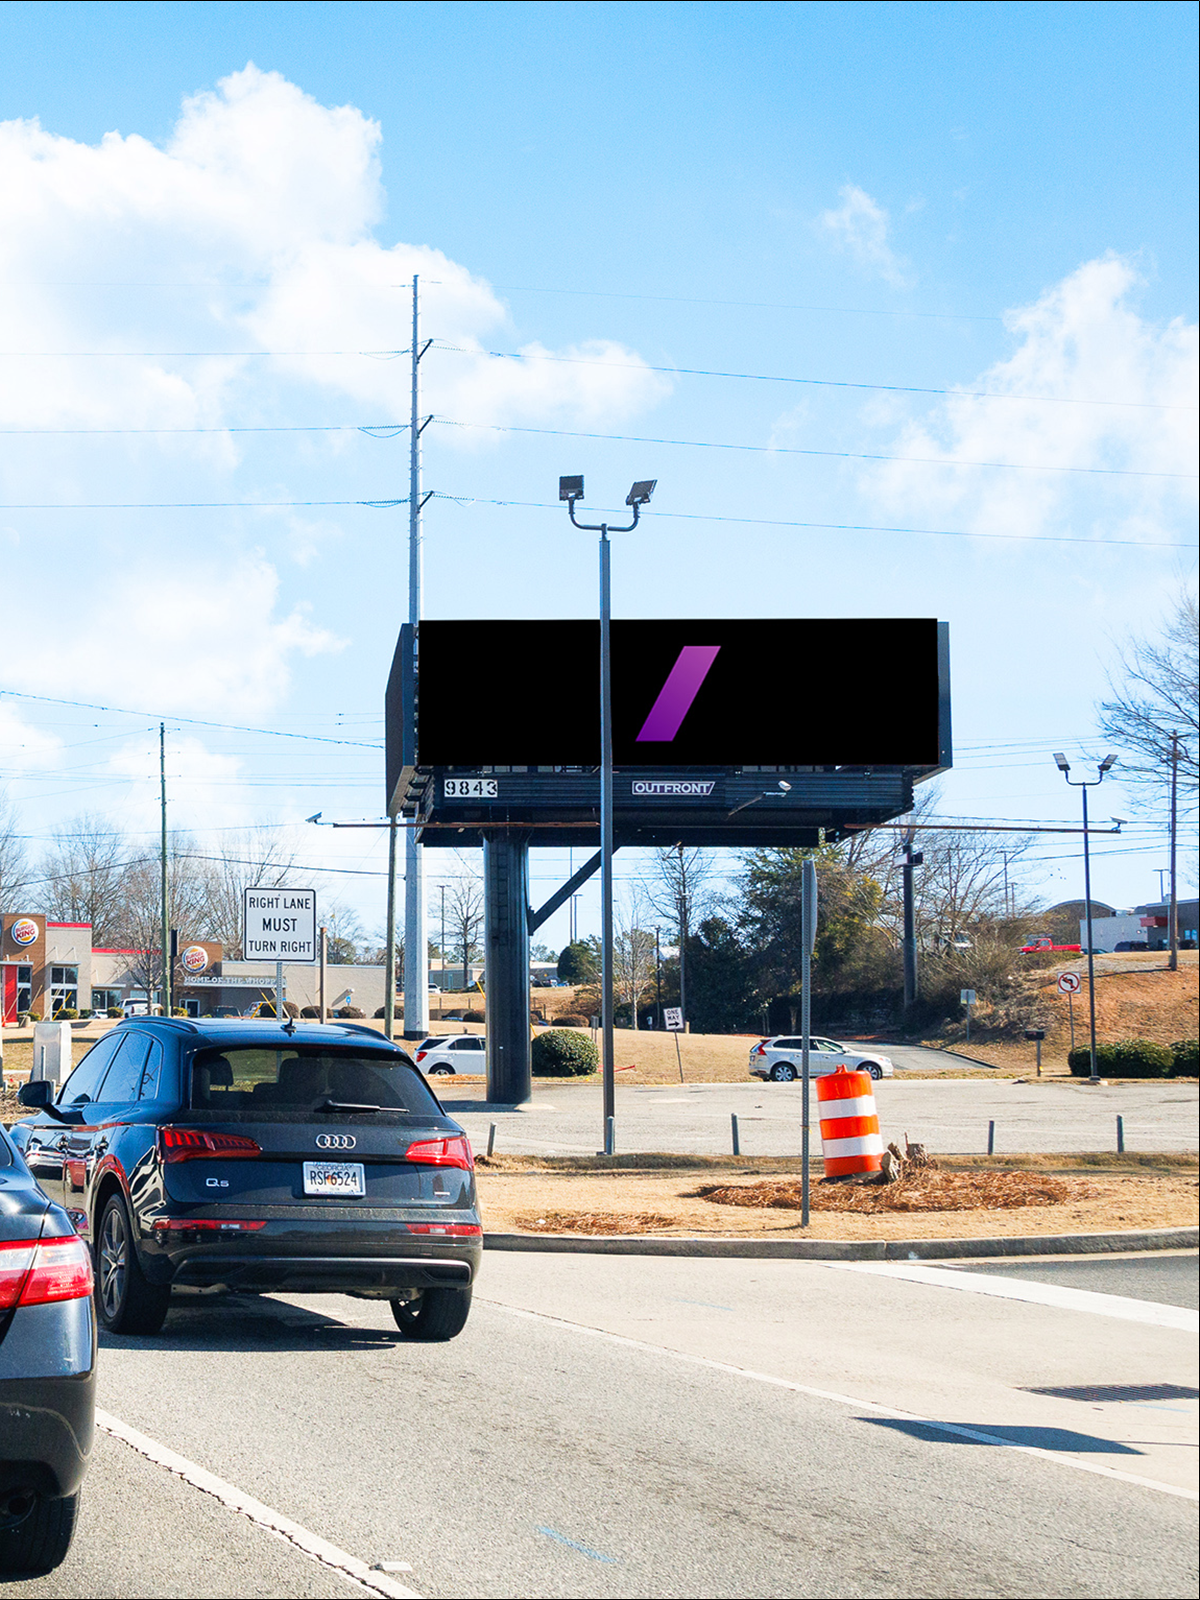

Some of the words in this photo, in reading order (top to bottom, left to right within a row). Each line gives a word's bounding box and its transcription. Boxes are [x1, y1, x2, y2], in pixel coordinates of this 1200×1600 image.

[446, 781, 497, 795] 9843
[635, 783, 710, 793] OUTFRONT
[249, 897, 280, 908] RIGHT
[284, 898, 311, 909] LANE
[15, 924, 34, 933] BURGER
[263, 918, 297, 932] MUST
[15, 928, 35, 940] KING
[249, 940, 276, 952] TURN
[281, 941, 311, 952] RIGHT
[186, 952, 204, 960] BURGER
[186, 955, 205, 966] KING
[245, 977, 287, 985] WHOPPR
[206, 1178, 229, 1187] Q5
